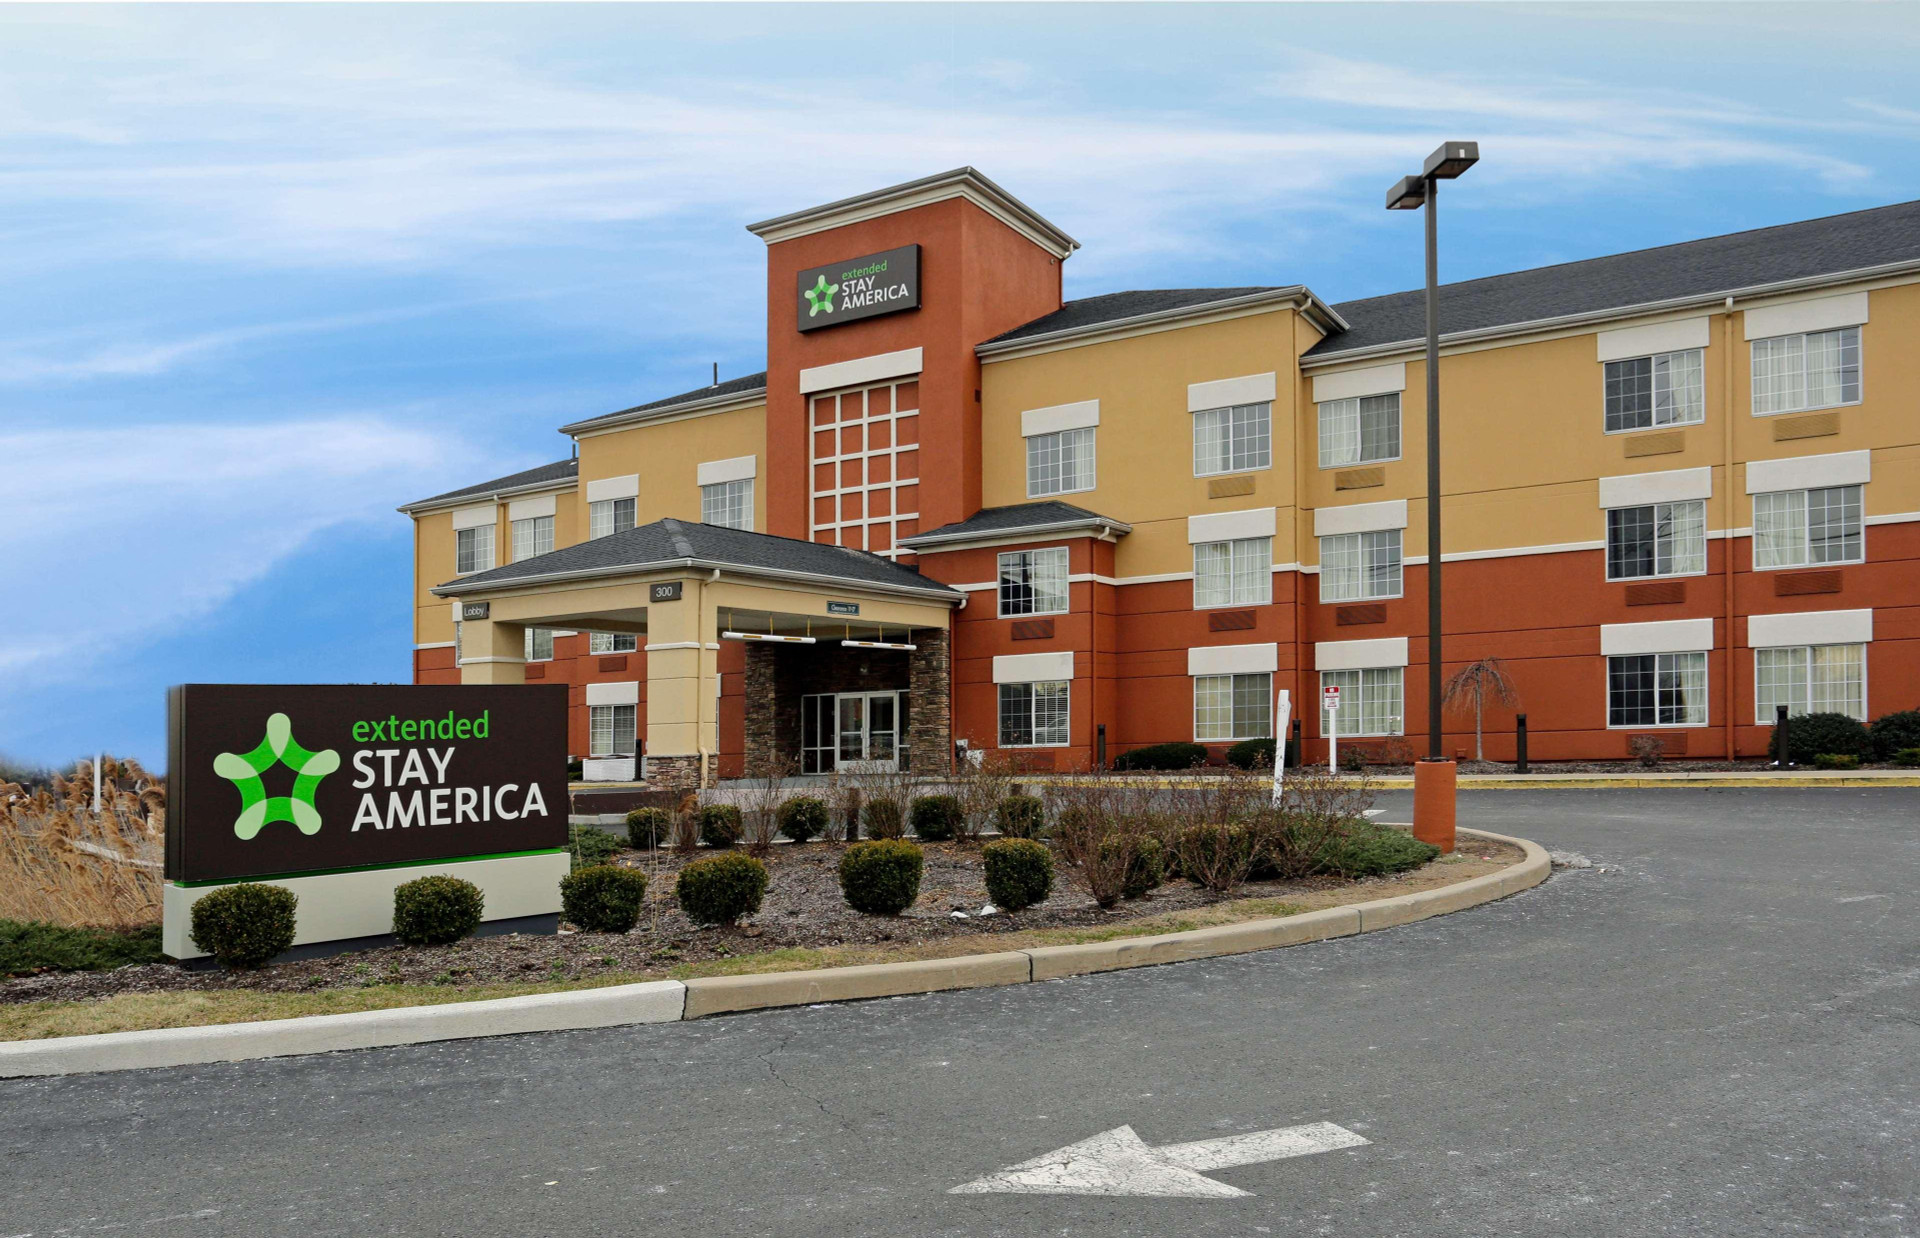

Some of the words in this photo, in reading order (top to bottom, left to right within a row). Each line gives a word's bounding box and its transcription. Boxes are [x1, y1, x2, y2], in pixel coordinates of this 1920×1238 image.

[841, 260, 888, 281] extended
[841, 276, 876, 296] STAY
[841, 283, 909, 311] AMERICA
[656, 586, 673, 598] 300
[464, 606, 485, 617] Lobby
[352, 709, 490, 743] extended
[351, 746, 456, 789] STAY
[350, 782, 549, 833] AMERICA
